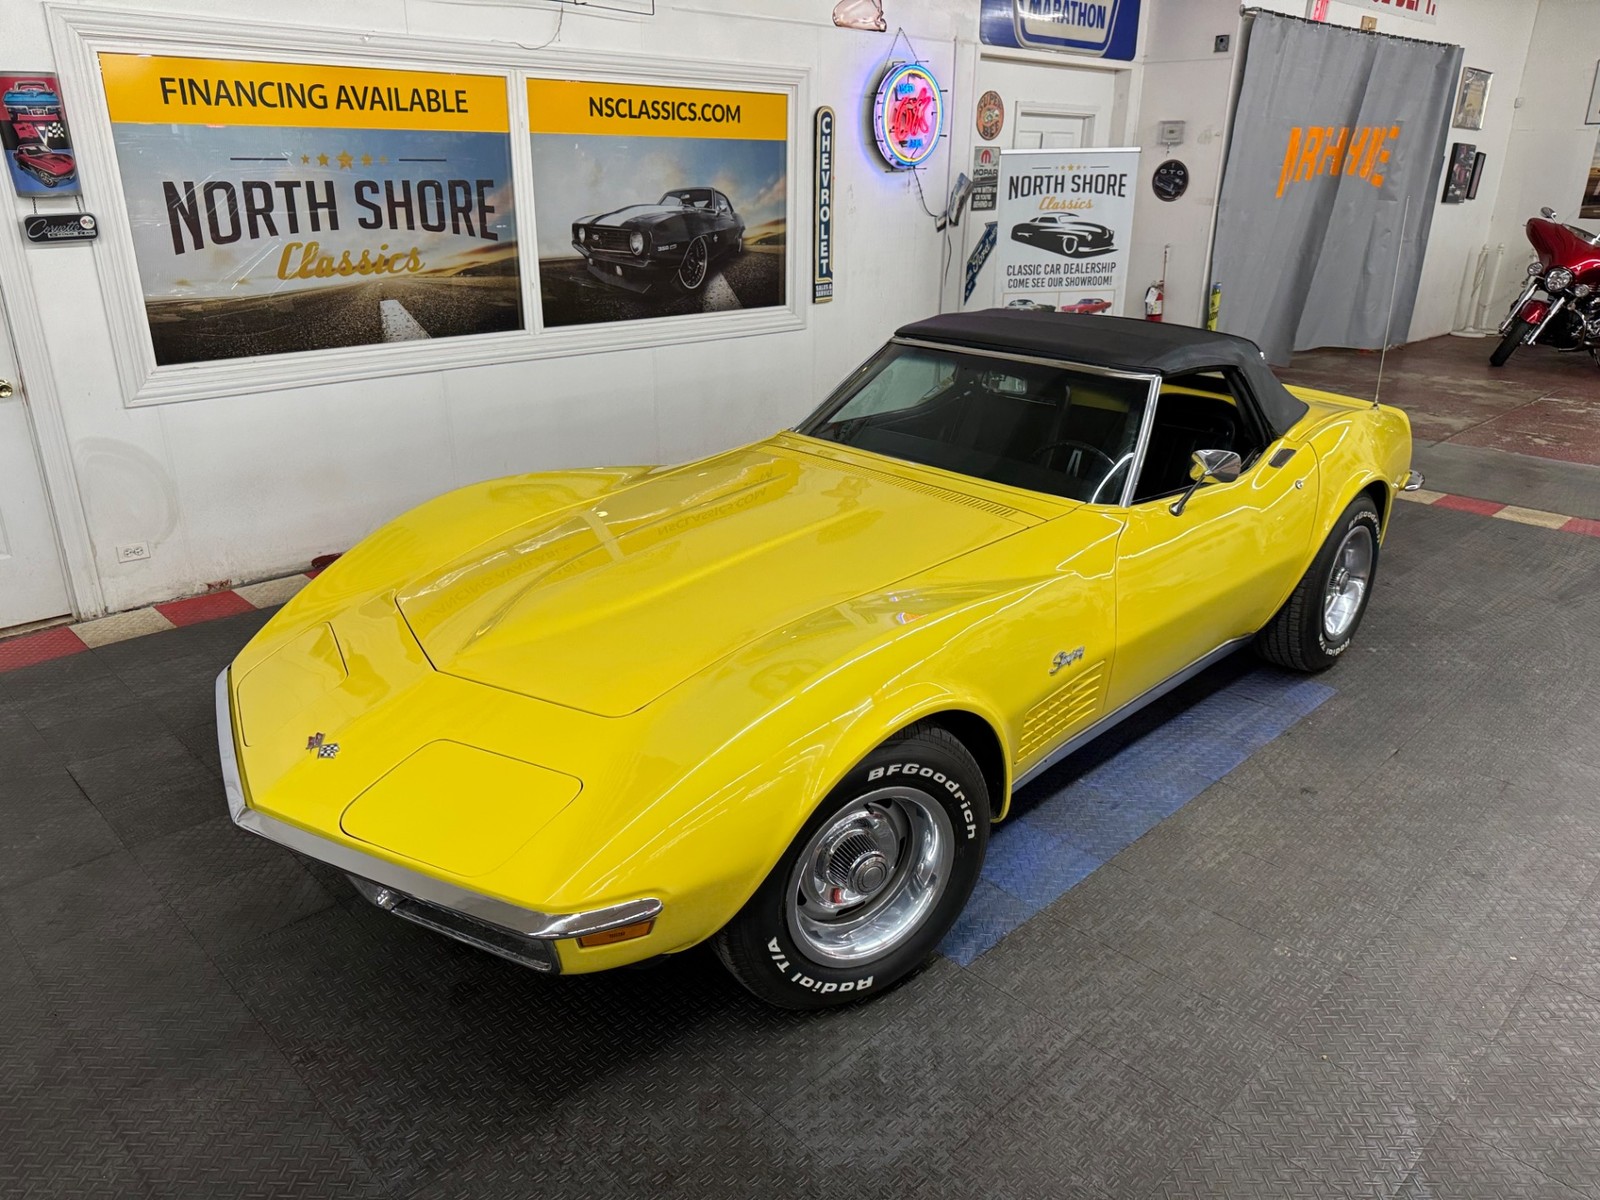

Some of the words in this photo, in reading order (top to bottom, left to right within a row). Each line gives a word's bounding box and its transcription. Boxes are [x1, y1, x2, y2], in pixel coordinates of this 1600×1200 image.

[1029, 0, 1107, 29] MARATHON
[160, 77, 328, 109] FINANCING
[335, 85, 469, 113] AVAILABLE
[589, 96, 741, 123] NSCLASSICS.COM
[973, 168, 998, 177] MOPAR
[1160, 168, 1184, 176] GTO
[820, 116, 832, 274] CHEVROLET
[1008, 174, 1065, 200] NORTH
[1071, 173, 1127, 198] SHORE
[162, 180, 339, 255] NORTH
[354, 179, 498, 241] SHORE
[1039, 196, 1093, 211] Classics
[28, 219, 81, 238] Corvette
[277, 241, 425, 281] Classics
[1006, 264, 1042, 276] CLASSIC
[1044, 263, 1061, 275] CAR
[1063, 262, 1116, 275] DEALERSHIP
[1007, 278, 1029, 288] COME
[1031, 277, 1046, 288] SEE
[1047, 277, 1063, 287] OUR
[1065, 275, 1113, 287] SHOWROOM!
[868, 763, 977, 839] BFGoodrich
[767, 936, 789, 973] T/A
[791, 972, 874, 994] Radial
